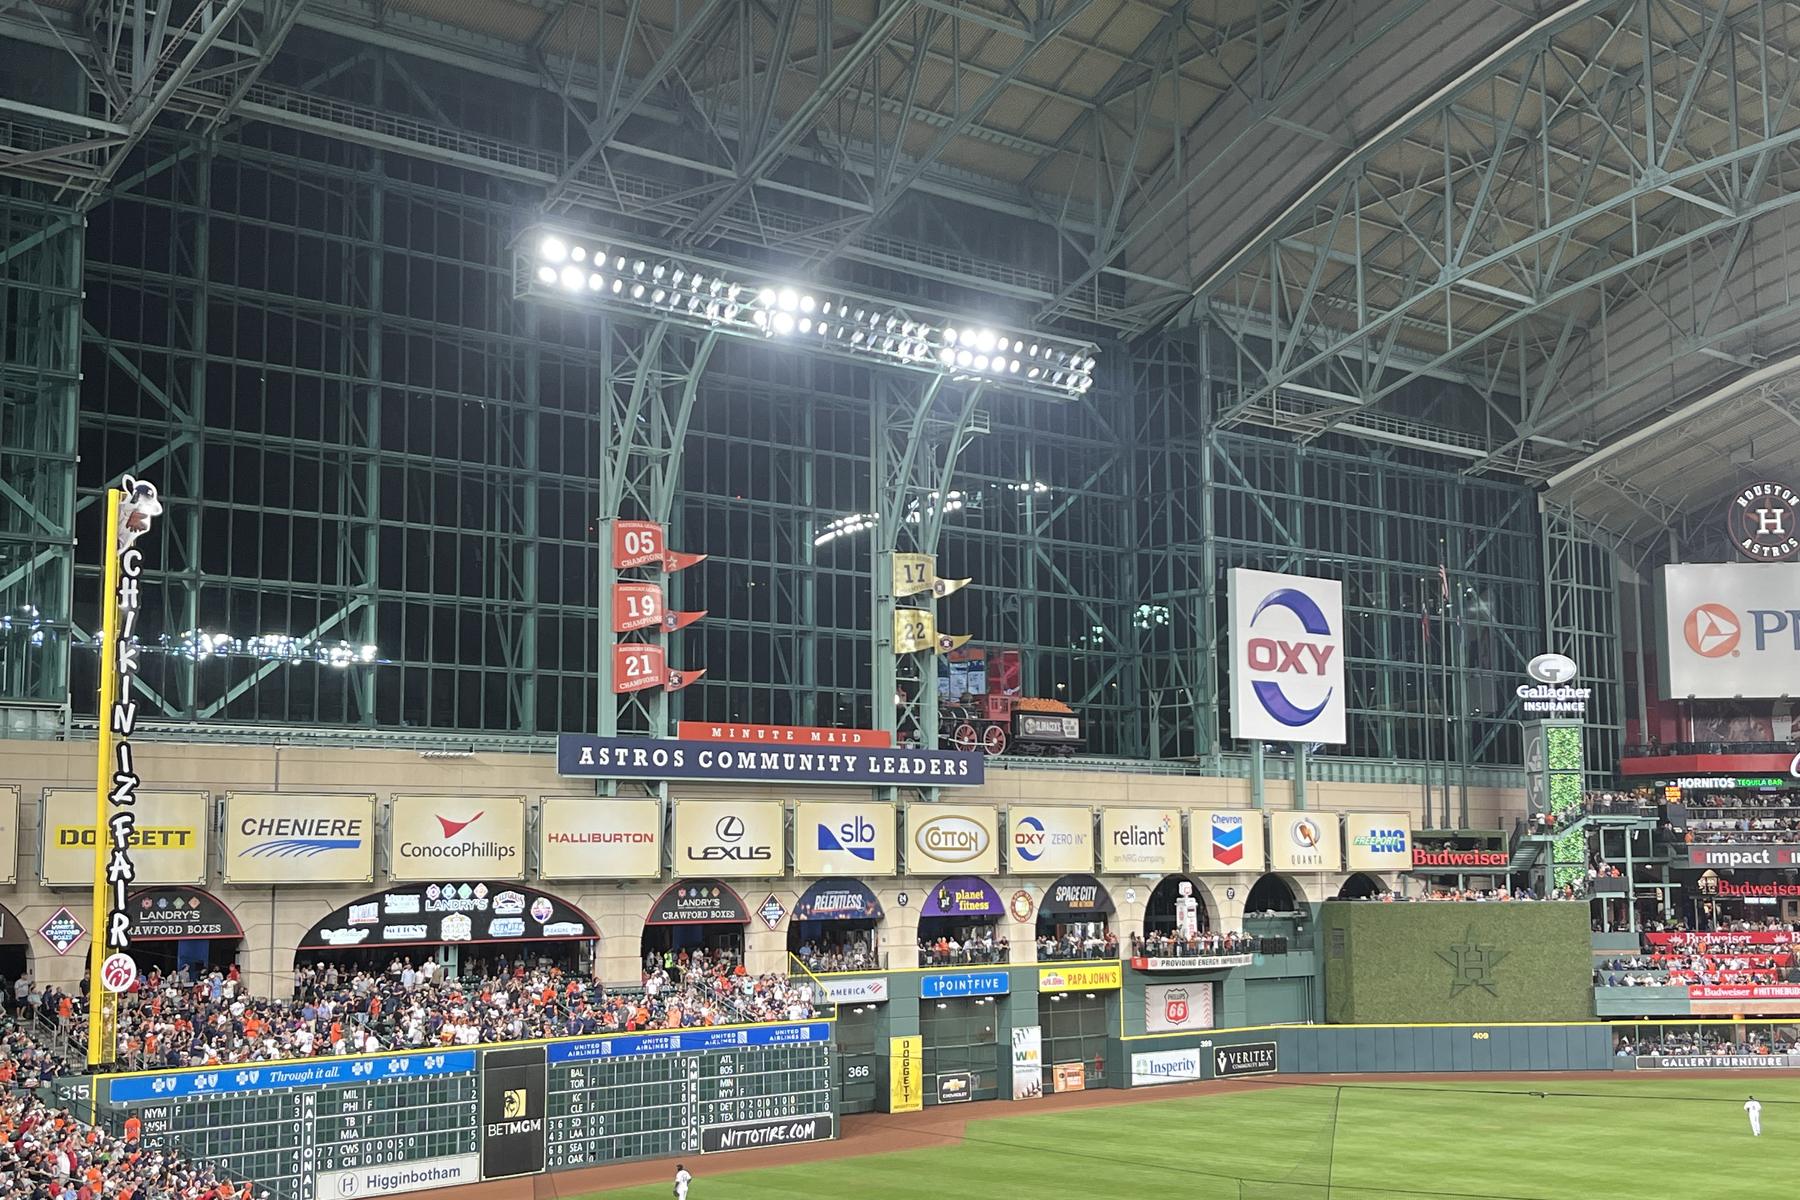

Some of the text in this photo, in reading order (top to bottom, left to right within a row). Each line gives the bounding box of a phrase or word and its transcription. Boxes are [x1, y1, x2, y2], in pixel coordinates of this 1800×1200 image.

[1736, 483, 1800, 508] HOUSTON
[1756, 508, 1785, 534] H
[624, 531, 655, 555] 05
[1741, 536, 1799, 557] ASTROS
[621, 552, 664, 567] CHAMPIONS
[903, 563, 926, 583] 17
[626, 595, 655, 617] 19
[622, 615, 663, 629] CHAMPIONS
[904, 622, 926, 641] 22
[1247, 637, 1335, 676] OXY
[625, 654, 652, 677] 21
[619, 676, 659, 689] CHAMPIONS
[1516, 685, 1592, 700] Gallagher
[1523, 701, 1586, 712] INSURANCE
[711, 727, 862, 743] MINUTE MAID
[107, 549, 143, 948] CHIKIN IZ FAIR
[578, 746, 971, 776] ASTROS COMMUNITY LEADERS
[1677, 778, 1736, 789] HORNITOS
[1210, 813, 1243, 825] Chevron
[240, 818, 363, 837] CHENIERE
[840, 815, 875, 843] slb
[60, 829, 192, 846] DOGETT
[548, 832, 654, 844] HALLIBURTON
[925, 826, 979, 852] COTTON
[1015, 832, 1045, 845] OXY
[1051, 832, 1073, 845] ZERO
[1113, 825, 1165, 847] reliant
[1352, 835, 1402, 846] FREEPORT
[1369, 829, 1406, 853] LNG
[400, 842, 516, 861] ConocoPhillips
[687, 846, 772, 860] LEXUS
[1124, 854, 1138, 863] NRG
[1412, 848, 1509, 867] Budweiser
[1706, 849, 1770, 867] impact
[1291, 854, 1323, 866] QUANTA
[1055, 885, 1097, 902] SPACE CITY
[1718, 879, 1800, 896] Budweiser
[677, 898, 720, 907] LANDRY'S
[814, 893, 863, 910] RELENTLESS
[899, 893, 907, 902] 24
[955, 889, 984, 903] planet
[425, 899, 490, 912] LANDRY'S
[959, 900, 989, 911] fitness
[139, 910, 201, 919] LANDRY'S
[662, 910, 735, 920] CRAWFORD BOXES
[187, 924, 222, 934] BOXES
[1685, 932, 1752, 945] Budweiser
[1160, 959, 1197, 967] PROVIDING
[934, 978, 999, 992] 1POINTFIVE
[1067, 974, 1087, 985] PAPA
[1088, 972, 1117, 984] JOHN'S
[830, 987, 866, 997] AMERICA
[1167, 993, 1186, 1001] PHILLIPS
[1704, 987, 1751, 996] Budweiser
[1168, 1003, 1185, 1018] 66
[769, 1033, 799, 1041] AIRLINES
[775, 1028, 799, 1037] UNITED
[574, 1043, 599, 1051] UNITED
[635, 1043, 669, 1051] AIRLINES
[641, 1038, 669, 1046] UNITED
[568, 1048, 599, 1057] AIRLINES
[720, 1055, 733, 1064] ATL
[1015, 1050, 1038, 1062] WM
[1228, 1050, 1273, 1064] VERITEX
[1149, 1057, 1196, 1076] Insperity
[1232, 1062, 1258, 1070] COMMUNITY
[1662, 1057, 1782, 1067] GALLERY FURNITURE
[270, 1066, 341, 1084] Through it all.
[570, 1068, 584, 1077] BAL
[720, 1065, 745, 1074] BOS F
[847, 1065, 869, 1078] 366
[902, 1039, 910, 1103] DOGGETT
[343, 1078, 476, 1100] MIL 1
[570, 1079, 584, 1088] TOR
[591, 1077, 596, 1086] F
[720, 1079, 733, 1087] MIN
[59, 1085, 89, 1101] 315
[572, 1083, 686, 1102] KC 5
[719, 1088, 745, 1098] NYY F
[144, 1095, 300, 1118] NYM F 6
[343, 1090, 477, 1112] PHI F 2
[570, 1093, 686, 1113] CLE F 8
[690, 1060, 698, 1148] AMERICAN
[720, 1093, 829, 1111] DET 1 3
[294, 1108, 300, 1117] 3
[345, 1104, 476, 1127] TB F 9
[721, 1112, 734, 1121] TEX
[340, 1115, 476, 1140] MIA 5
[488, 1119, 542, 1137] BETMGM
[571, 1118, 581, 1127] SD
[569, 1130, 583, 1139] LAA
[721, 1120, 816, 1148] NITTOTIRE.COM
[303, 1095, 315, 1199] NATIONAL
[339, 1129, 476, 1155] CWS 5 5
[569, 1144, 583, 1152] SEA
[343, 1156, 357, 1166] CHI
[568, 1154, 584, 1164] OAK
[366, 1166, 461, 1189] Higginbotham
